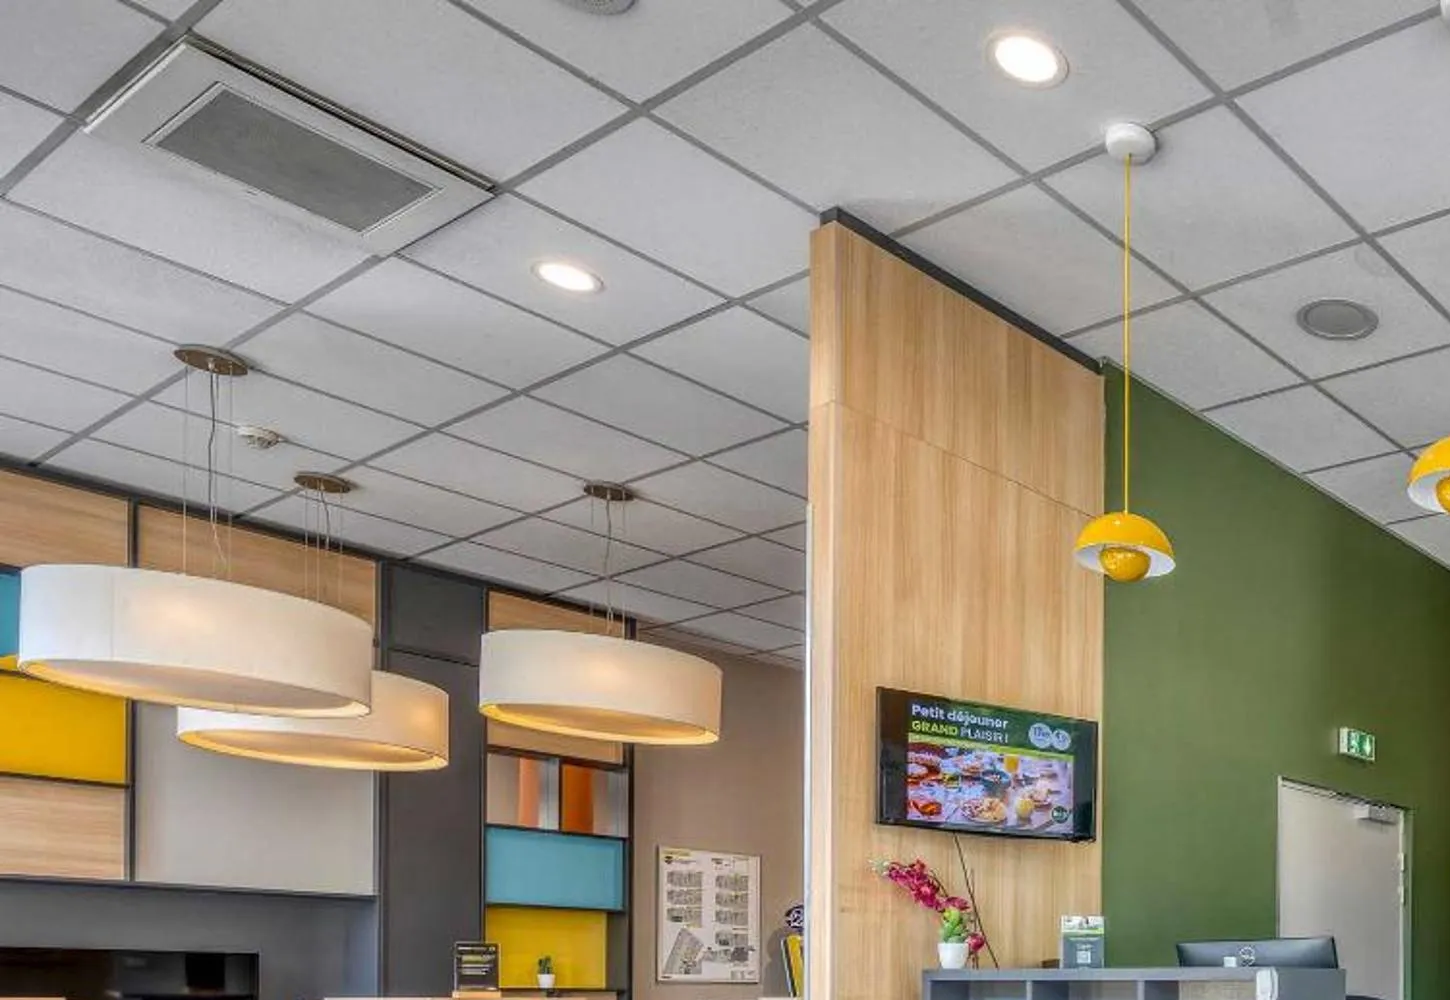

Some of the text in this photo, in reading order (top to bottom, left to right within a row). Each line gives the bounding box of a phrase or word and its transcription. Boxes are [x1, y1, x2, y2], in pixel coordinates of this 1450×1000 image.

[912, 704, 1008, 729] Petit déjeuner
[912, 720, 958, 736] GRAND
